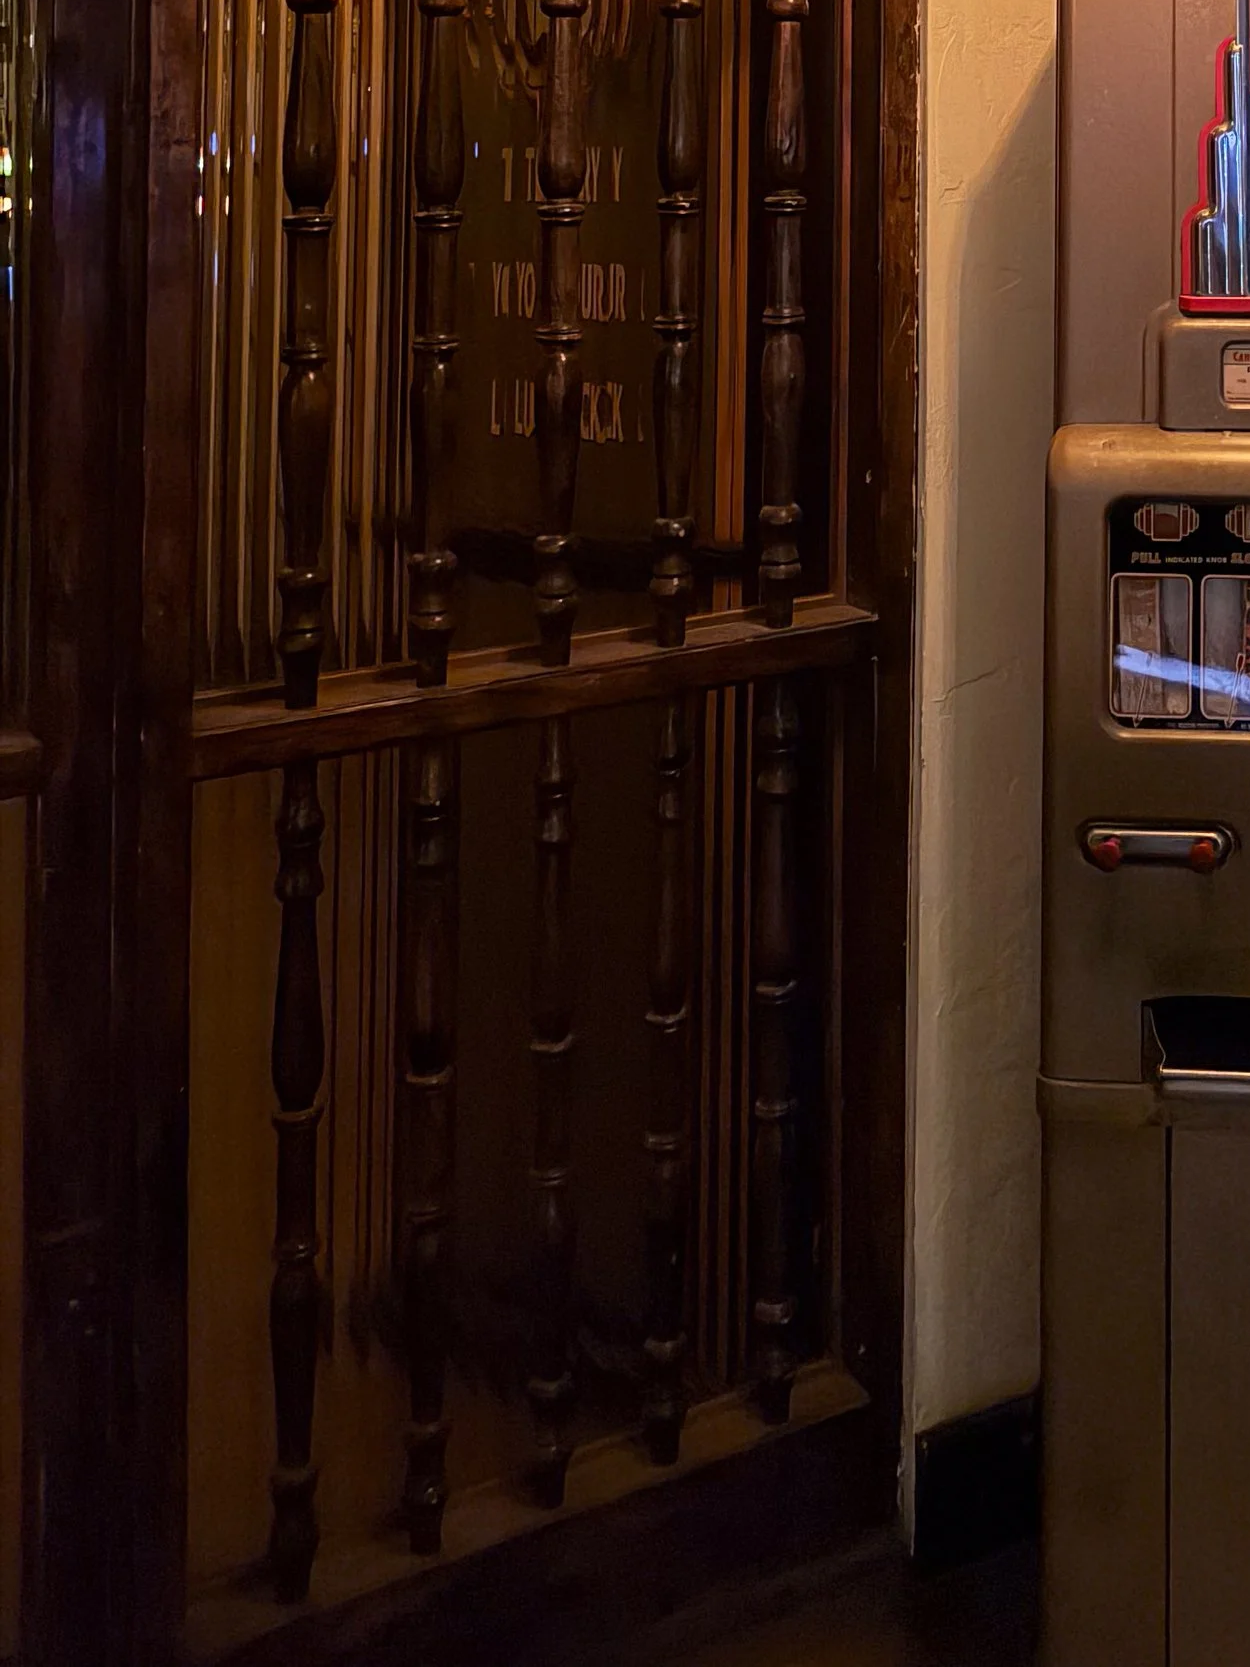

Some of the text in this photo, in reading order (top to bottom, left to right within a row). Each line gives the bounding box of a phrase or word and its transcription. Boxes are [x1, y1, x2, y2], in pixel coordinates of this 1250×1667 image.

[1131, 551, 1162, 564] PULL
[1165, 556, 1204, 564] INDICATED
[1206, 556, 1227, 564] KNOB
